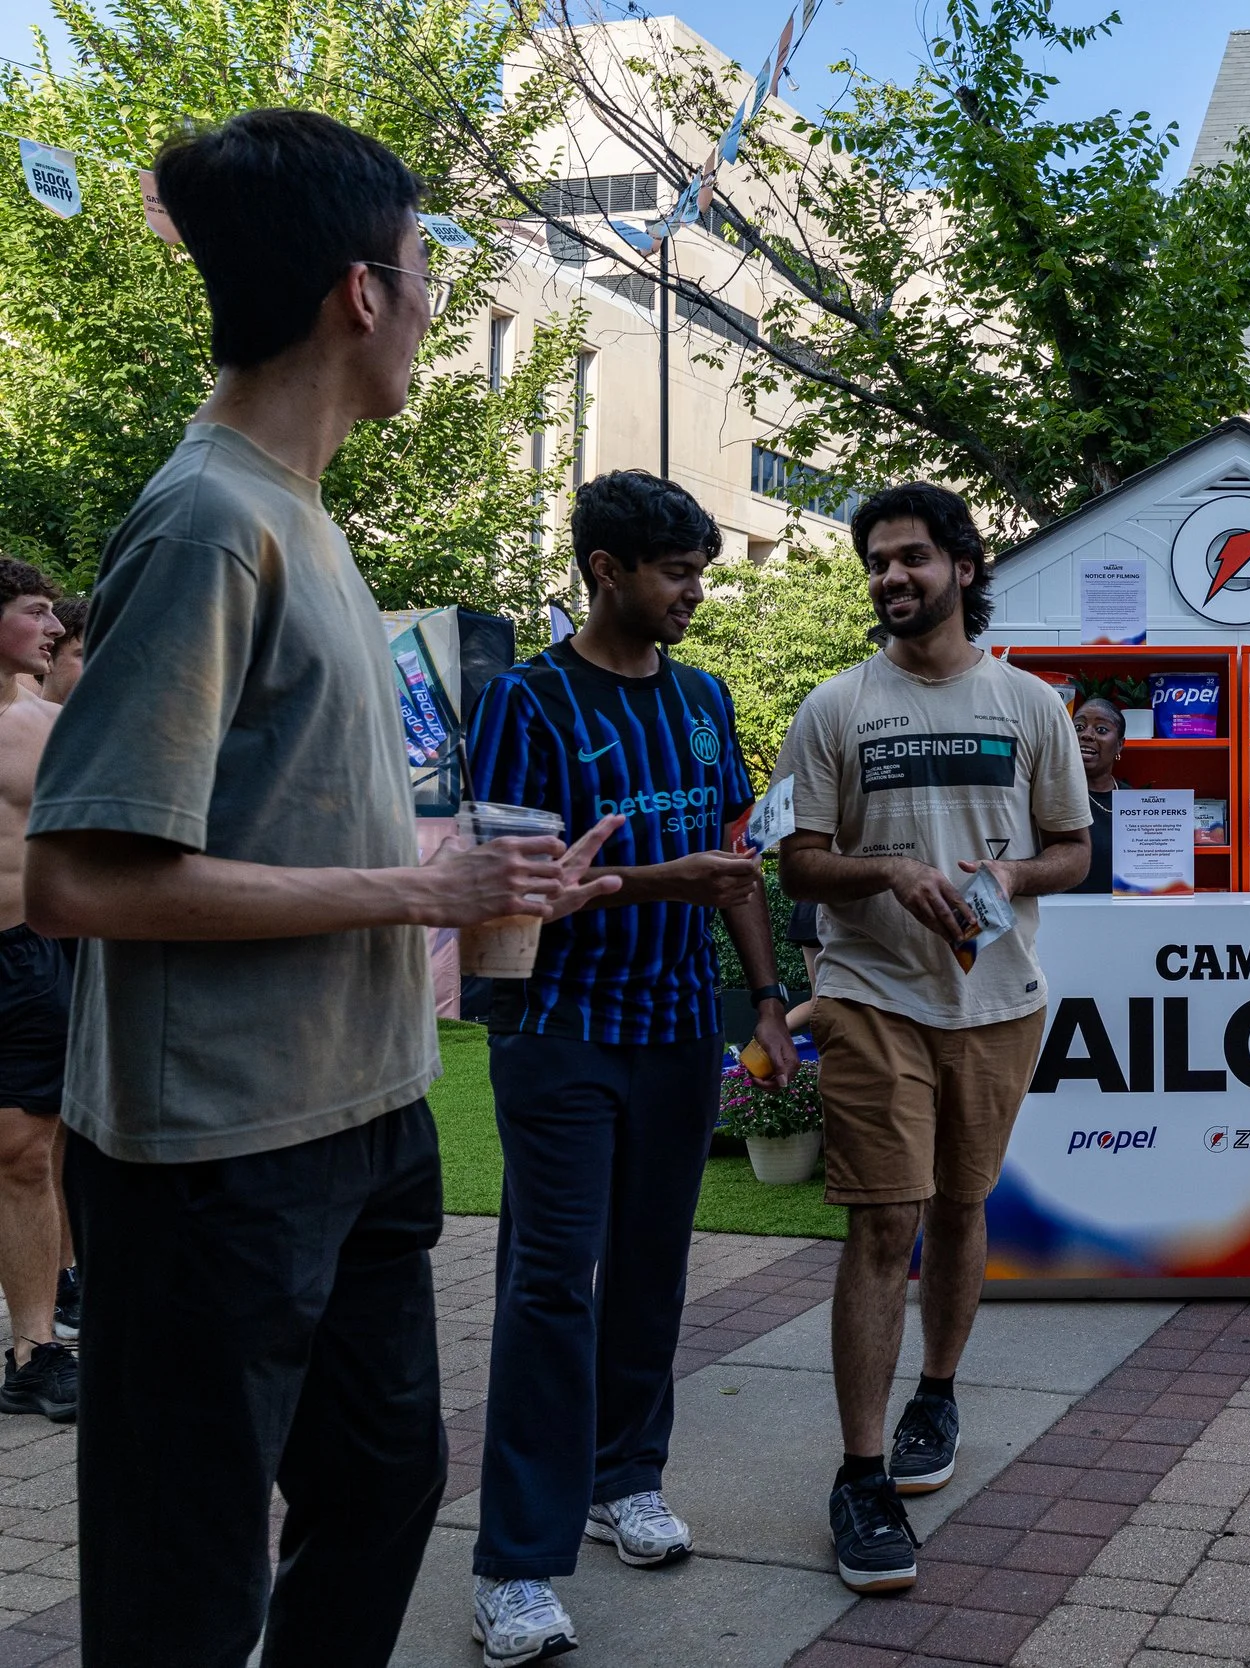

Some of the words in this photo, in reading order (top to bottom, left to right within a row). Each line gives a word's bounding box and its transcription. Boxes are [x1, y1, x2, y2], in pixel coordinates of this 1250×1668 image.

[32, 168, 72, 190] BLOCK
[35, 182, 72, 202] PARTY
[438, 234, 467, 242] PARTY
[1152, 686, 1220, 708] propel
[412, 690, 446, 736] propel
[857, 716, 909, 734] UNDFTD
[864, 739, 978, 763] RE-DEFINED
[594, 786, 717, 819] betsson
[662, 808, 717, 834] .sport
[863, 844, 890, 853] GLOBAL
[1067, 1126, 1156, 1154] propel
